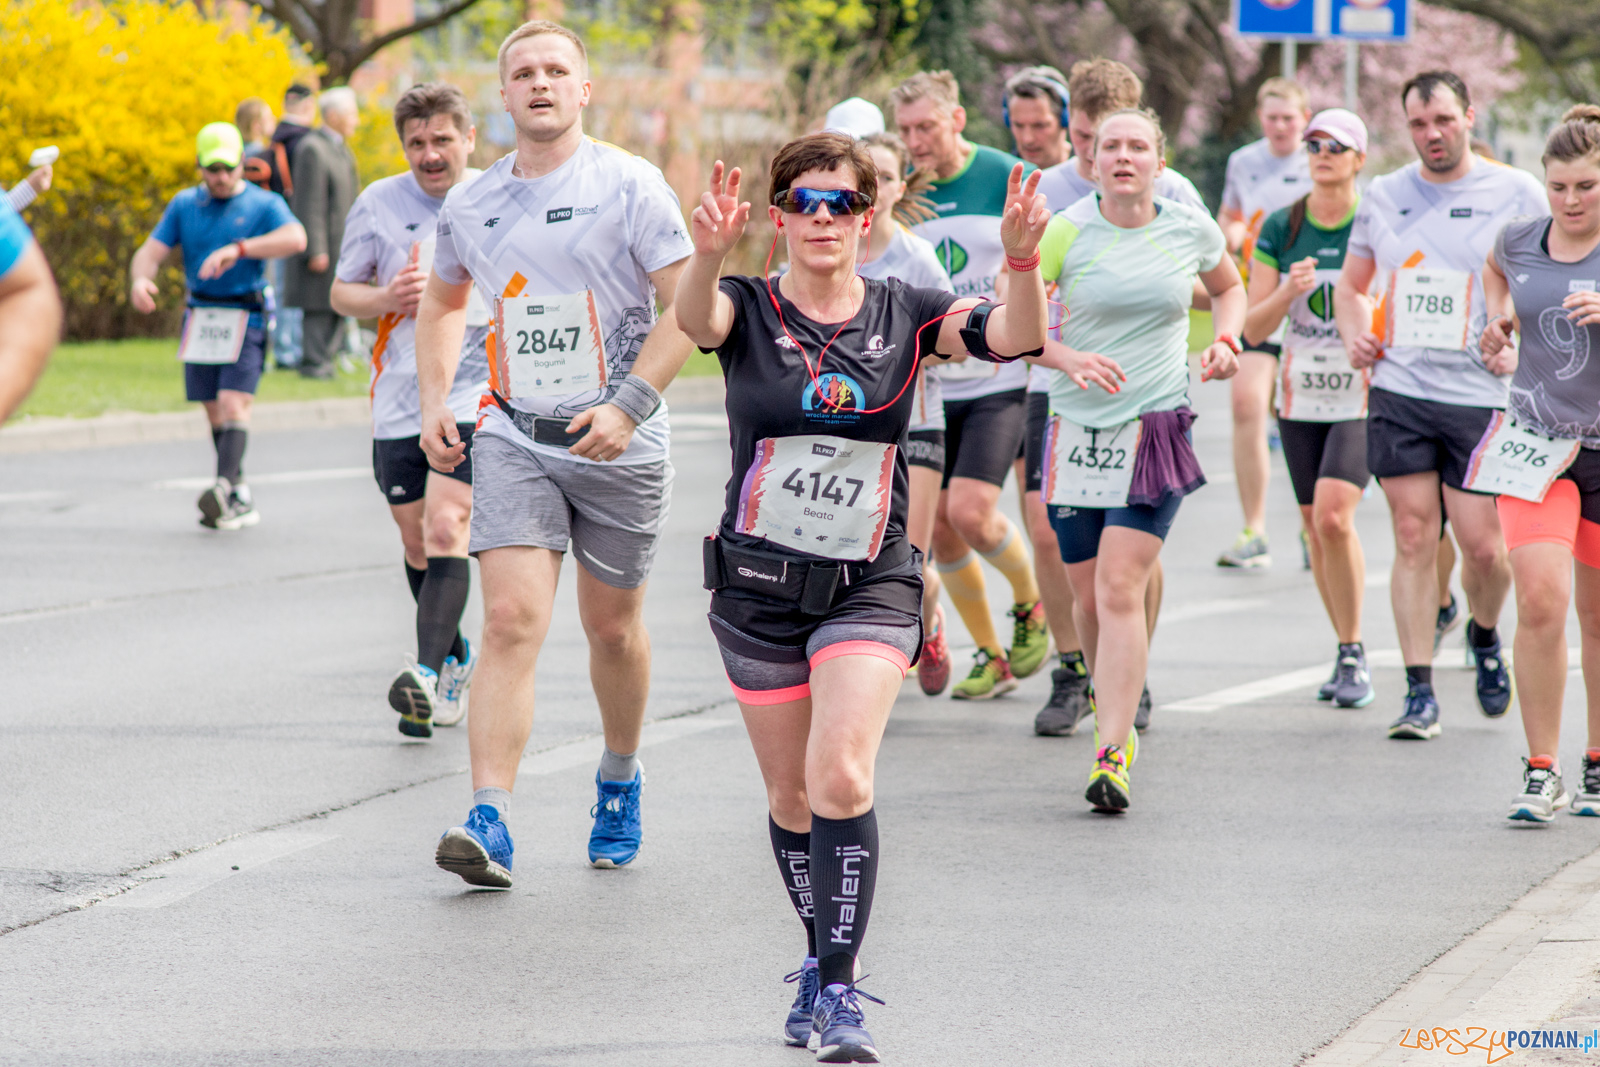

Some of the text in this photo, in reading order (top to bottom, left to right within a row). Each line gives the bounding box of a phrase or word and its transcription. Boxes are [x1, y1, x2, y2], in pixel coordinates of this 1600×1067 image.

[1406, 294, 1453, 315] 1788
[516, 326, 581, 355] 2847
[1301, 372, 1354, 391] 3307
[1068, 445, 1126, 470] 4322
[1498, 440, 1550, 468] 9916
[782, 467, 864, 508] 4147
[803, 506, 834, 521] Beata
